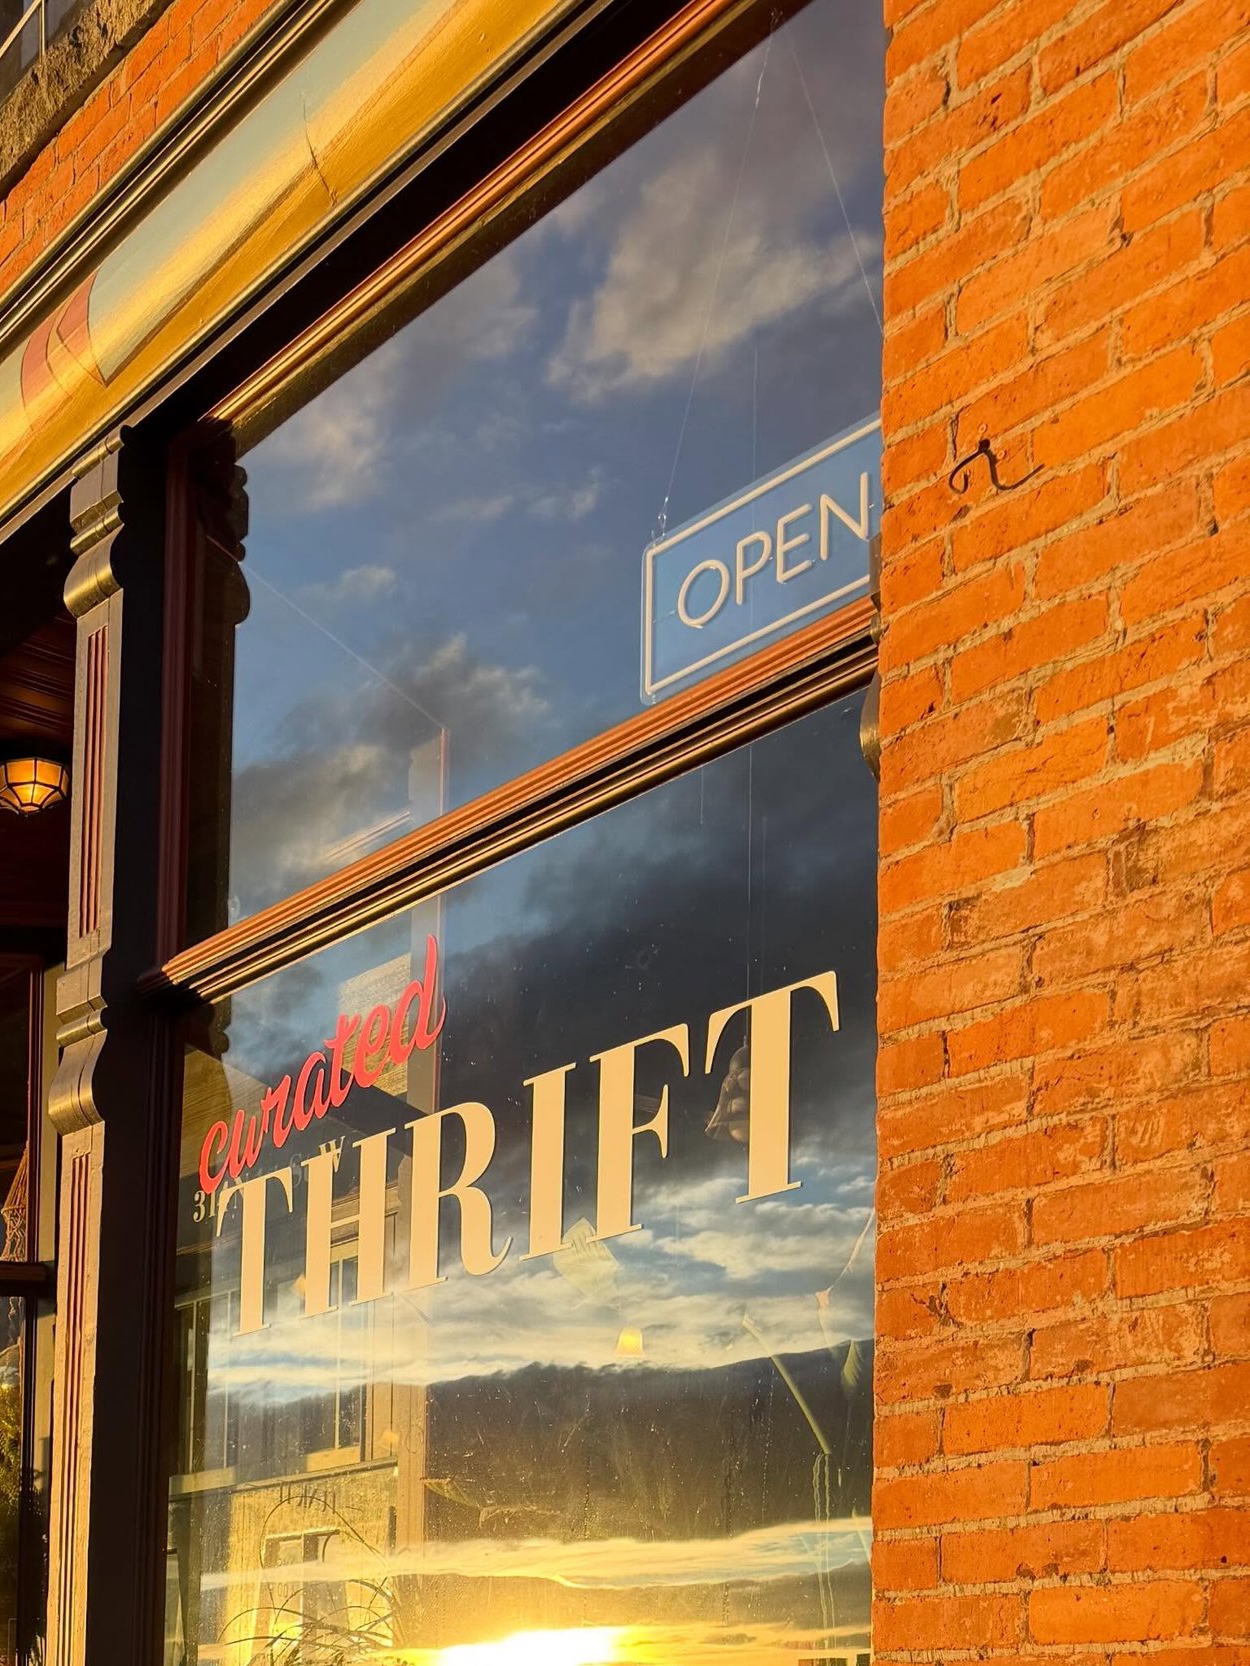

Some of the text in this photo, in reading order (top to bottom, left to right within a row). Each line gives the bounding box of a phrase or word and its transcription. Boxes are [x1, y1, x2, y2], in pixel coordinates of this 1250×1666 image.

[676, 471, 870, 629] OPEN
[198, 933, 448, 1195] curated
[216, 969, 842, 1337] THRIFT
